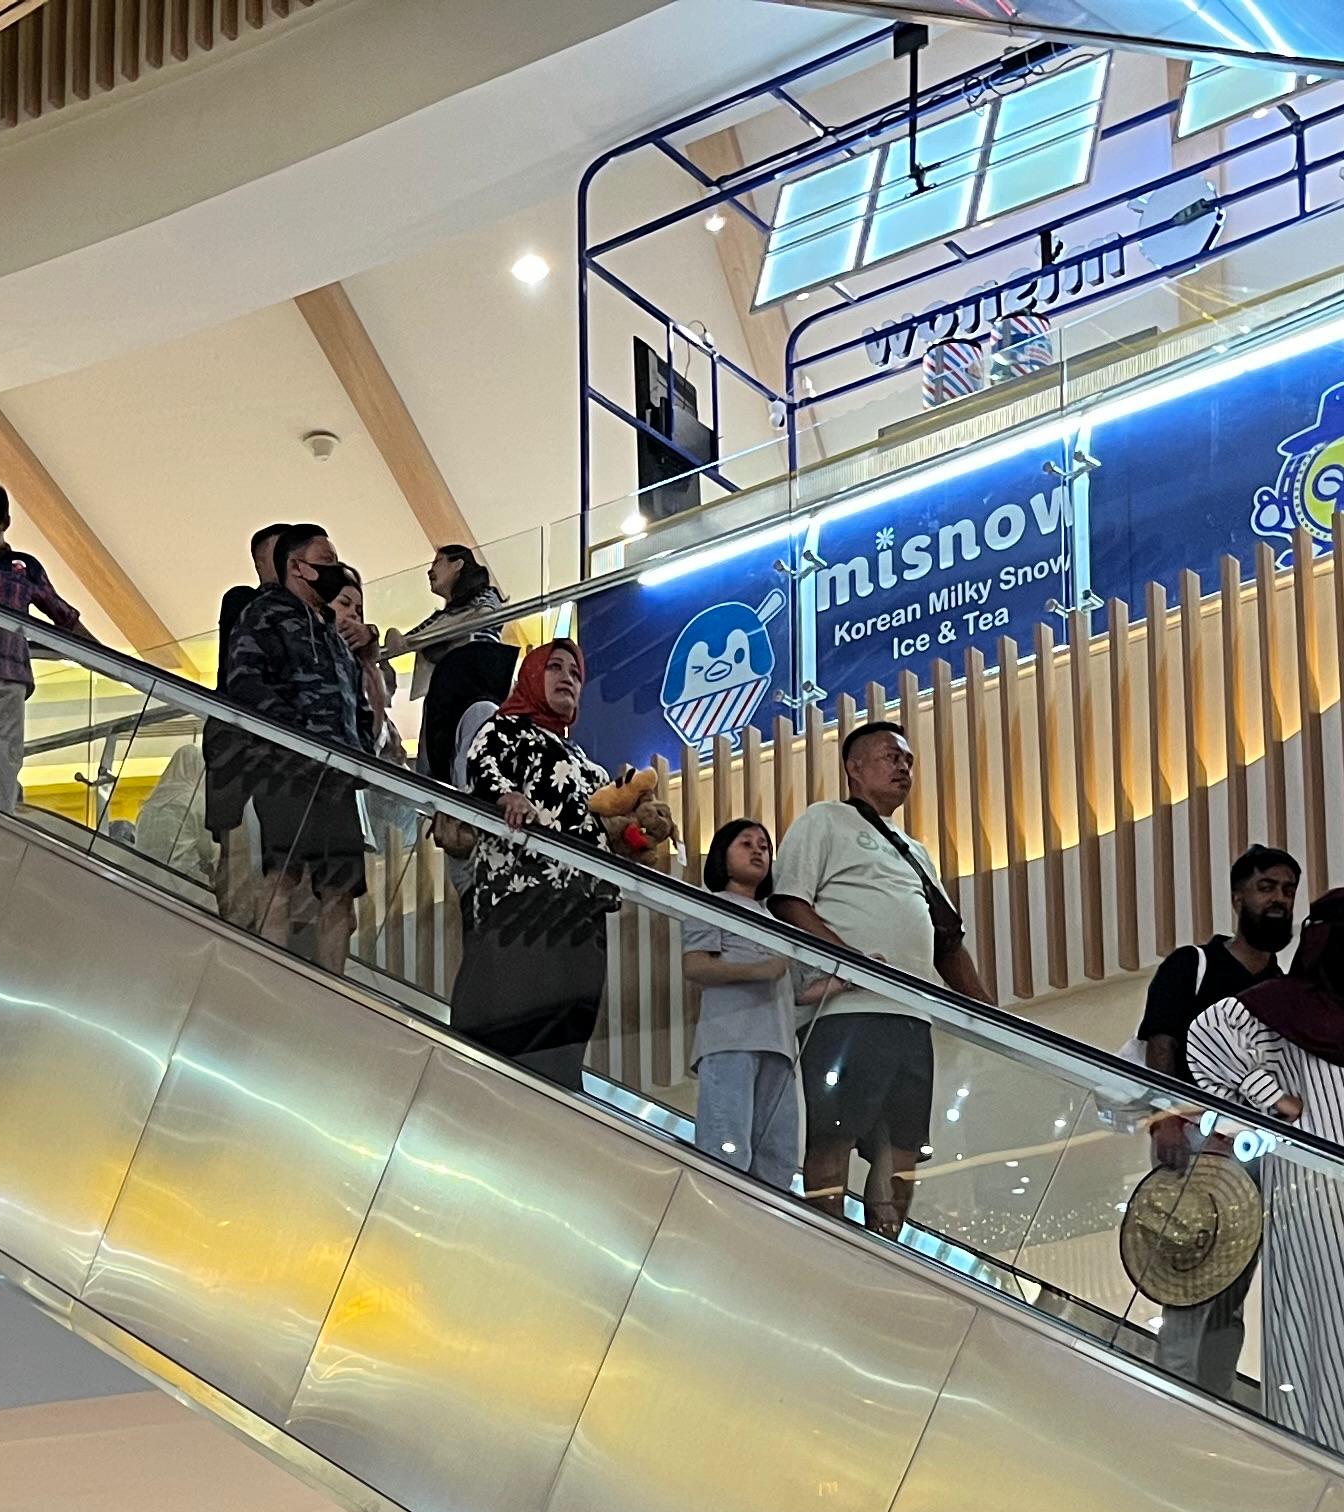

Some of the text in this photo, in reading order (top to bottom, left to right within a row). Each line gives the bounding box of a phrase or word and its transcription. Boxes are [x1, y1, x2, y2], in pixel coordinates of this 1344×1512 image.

[816, 485, 1074, 613] misnow
[834, 553, 1072, 647] Korean Milky Snow
[892, 606, 1010, 660] Ice & Tea
